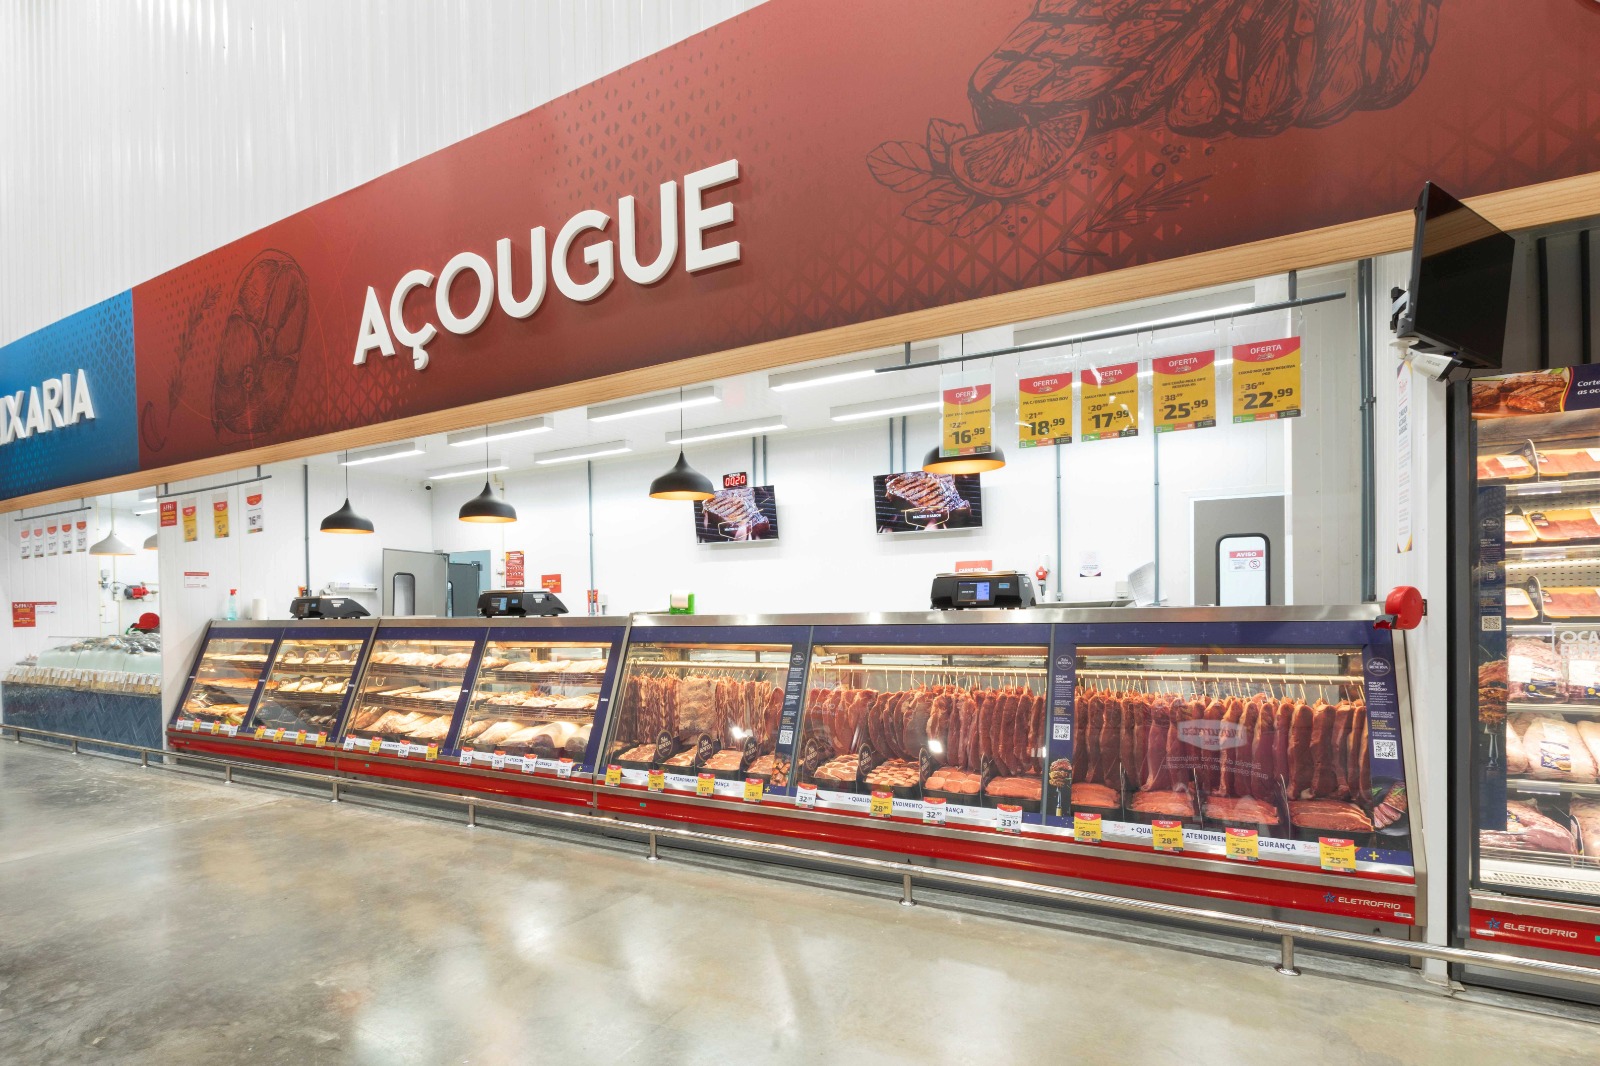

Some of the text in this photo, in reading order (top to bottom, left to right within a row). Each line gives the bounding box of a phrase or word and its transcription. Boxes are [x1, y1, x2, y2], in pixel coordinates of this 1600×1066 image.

[353, 158, 741, 371] AÇOUGUE
[1250, 344, 1282, 355] OFERTA
[1168, 357, 1198, 367] OFERTA
[1100, 369, 1123, 377] FERTA
[1033, 379, 1059, 388] OFERTA
[1243, 387, 1293, 410] 22,99
[1164, 399, 1209, 420] 25,99
[1028, 417, 1066, 436] 18,99
[1091, 409, 1130, 429] 17,99
[952, 427, 985, 445] 16,99
[725, 475, 746, 487] 0020
[892, 800, 923, 810] ENDIMENTO
[945, 806, 964, 815] RANÇA
[1185, 832, 1226, 843] ATENDIMEN
[1258, 840, 1297, 851] GURANÇA
[1338, 896, 1401, 910] ELETROFRIO
[1503, 922, 1578, 939] ELETROFRIO
